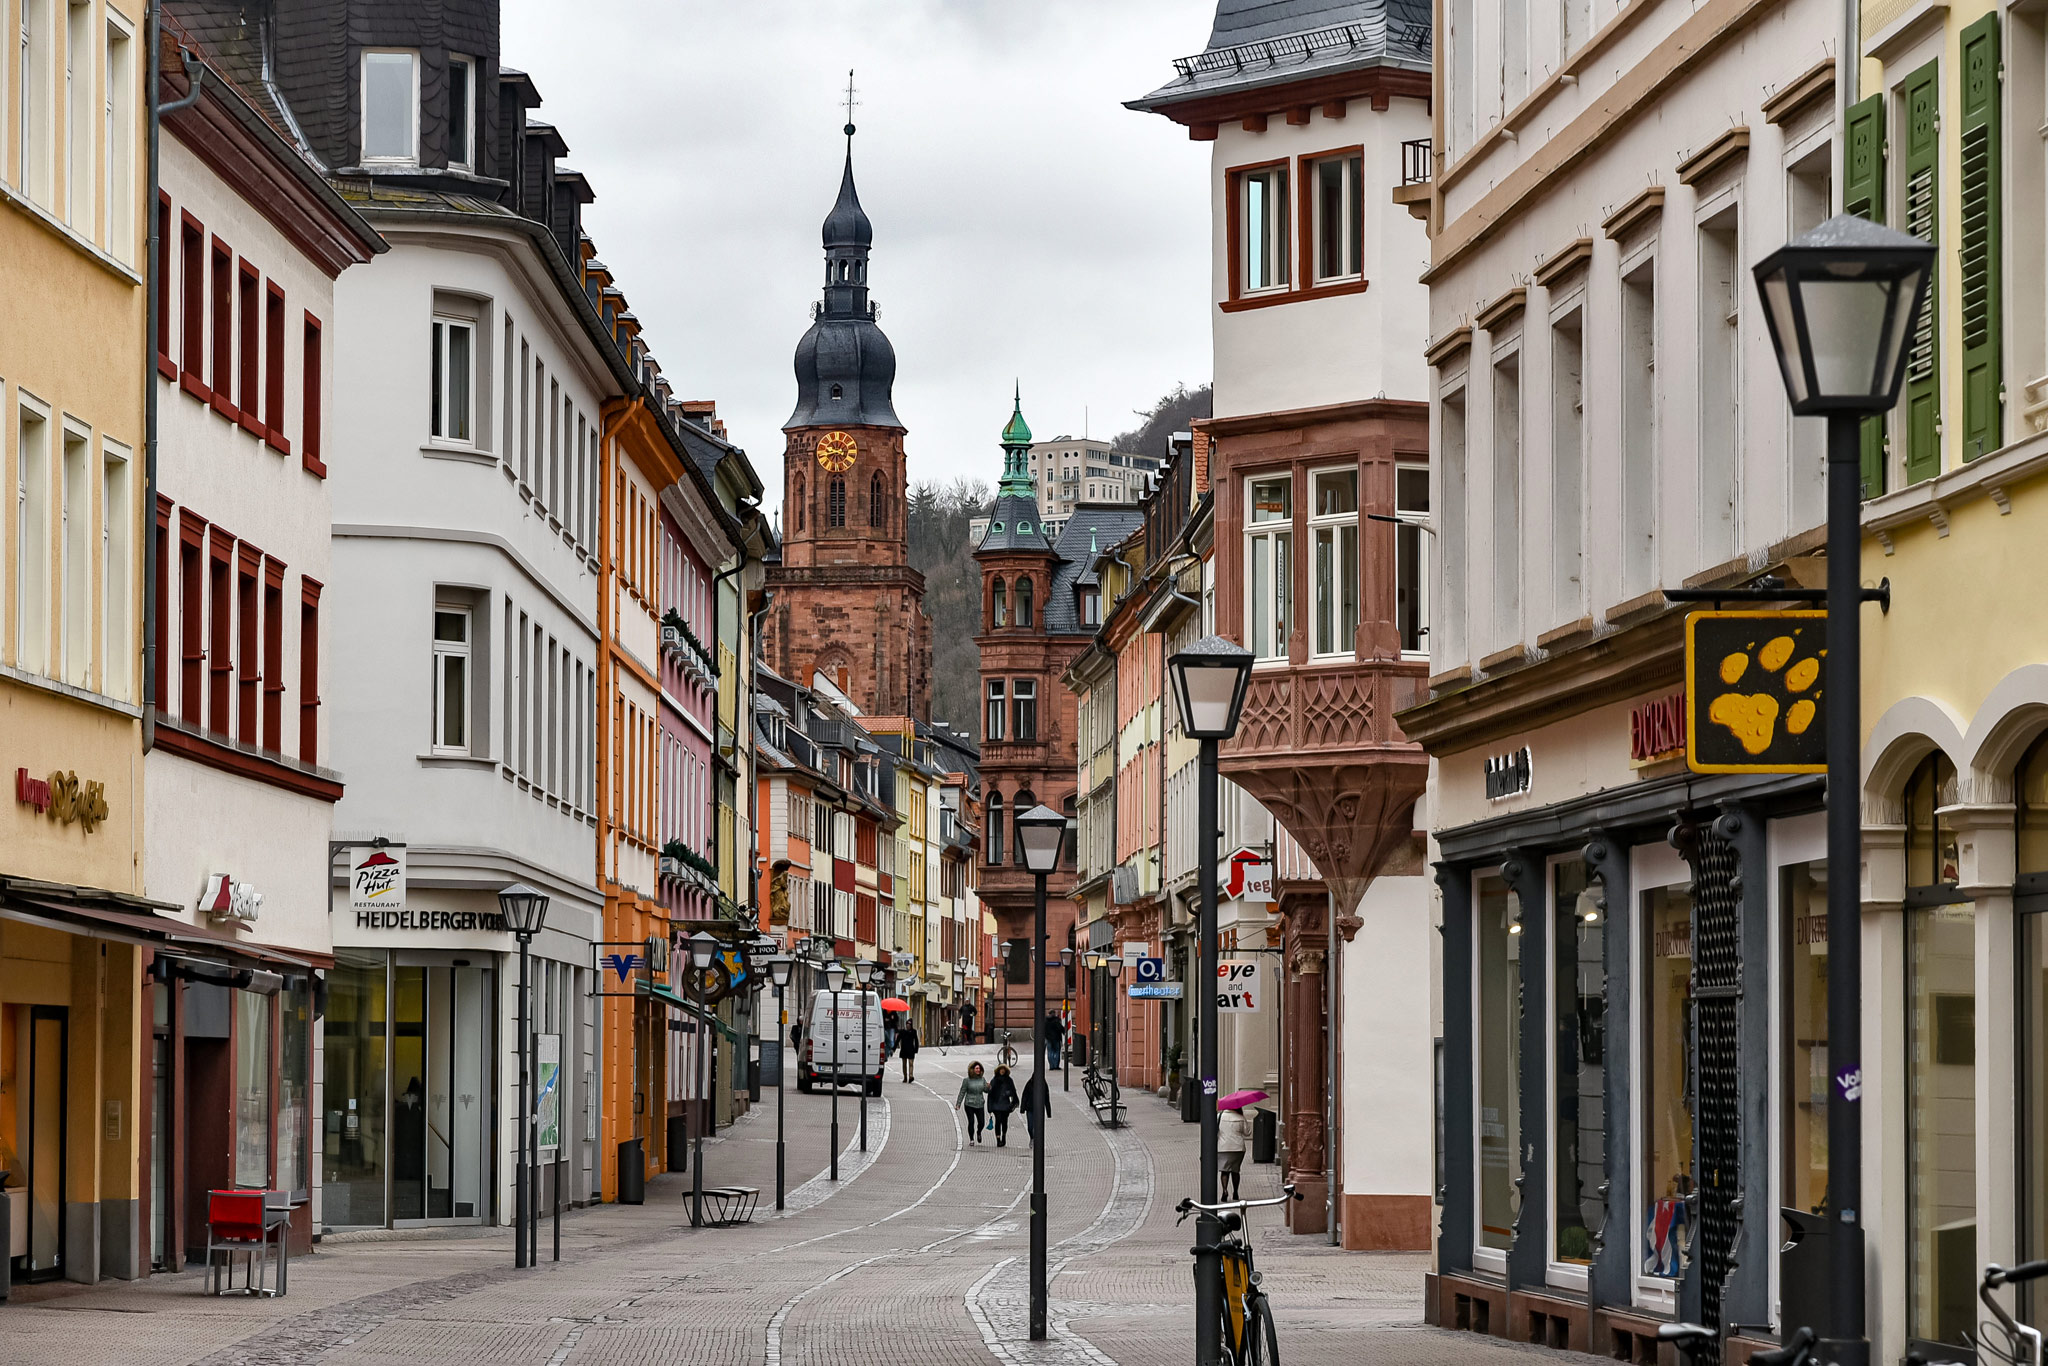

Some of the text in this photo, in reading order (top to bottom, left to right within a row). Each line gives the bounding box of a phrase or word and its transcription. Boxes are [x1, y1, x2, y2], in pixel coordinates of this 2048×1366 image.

[356, 866, 400, 889] Pizza
[364, 878, 395, 895] Hut
[357, 911, 477, 931] HEIDELBERGER
[759, 946, 776, 954] 1900
[1217, 964, 1255, 981] eye
[1228, 982, 1243, 991] and
[1217, 991, 1254, 1008] art
